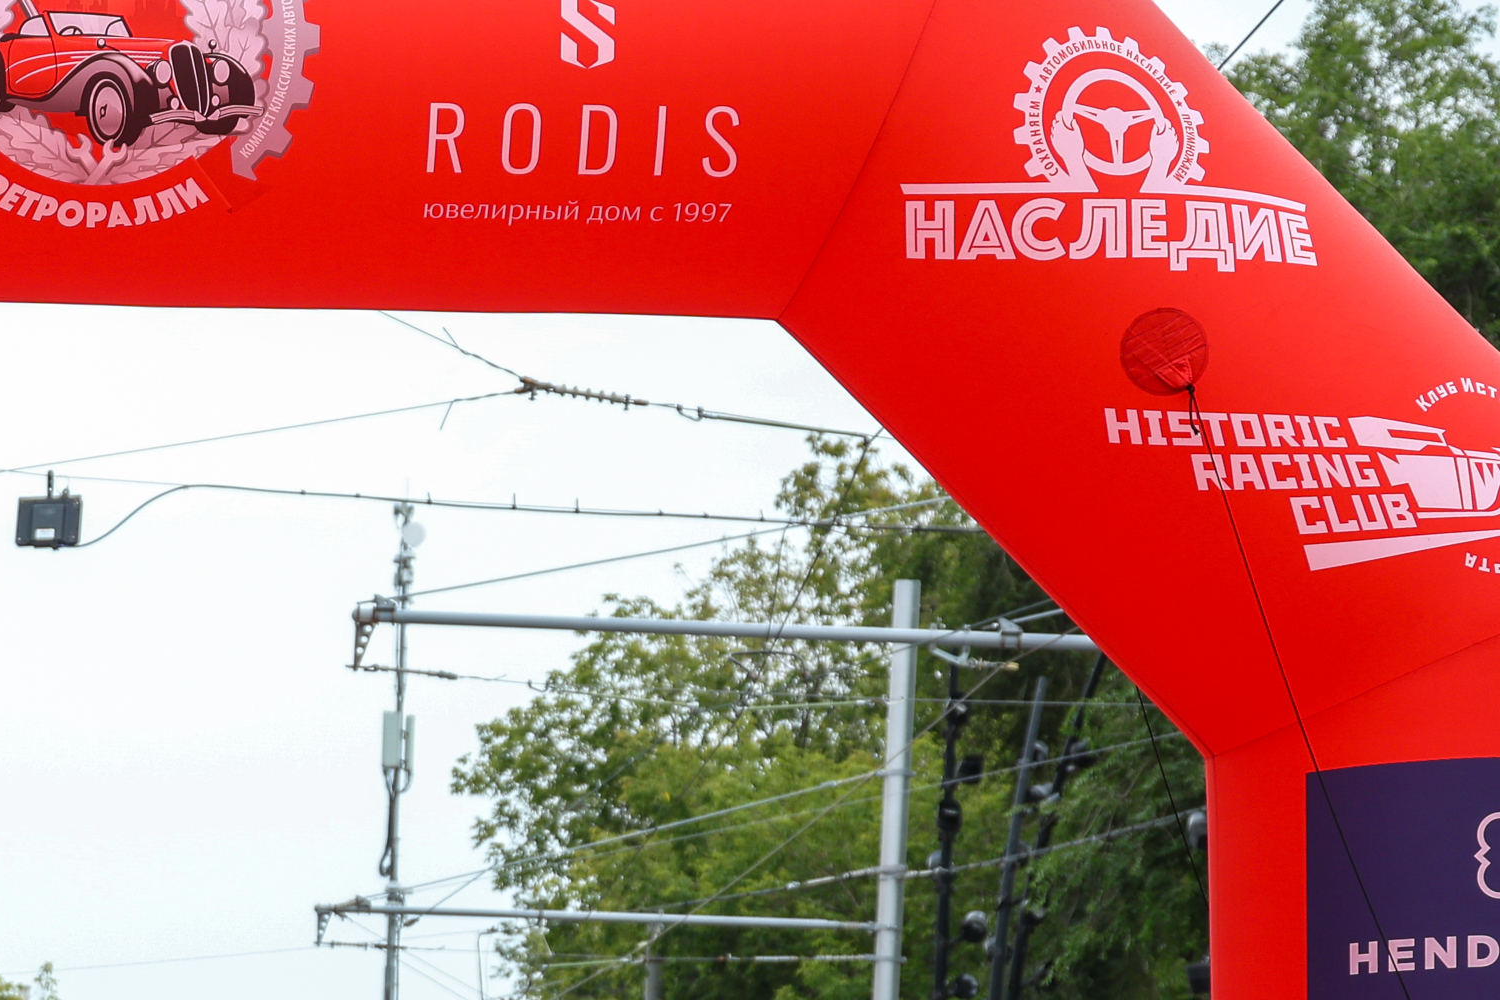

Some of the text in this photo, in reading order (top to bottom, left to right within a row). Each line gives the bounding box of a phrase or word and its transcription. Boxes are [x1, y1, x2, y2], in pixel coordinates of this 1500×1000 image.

[239, 111, 276, 158] КОМИТЕТ
[270, 27, 297, 113] КЛАССИЧЕСКИХ
[1029, 39, 1196, 183] СОХРАНЯЕМ АВТОМОБИЛЬНОЕ НАСЛЕДИЕ ПРЕУМНОЖАЕМ
[426, 102, 740, 177] RODIS
[423, 200, 732, 226] ювелирный дом с 1997
[905, 197, 1318, 273] НАСЛЕДИЕ
[1104, 407, 1349, 448] HISTORIC
[1190, 453, 1381, 491] RACING
[1290, 493, 1418, 535] CLUB
[1349, 935, 1500, 975] HEND
